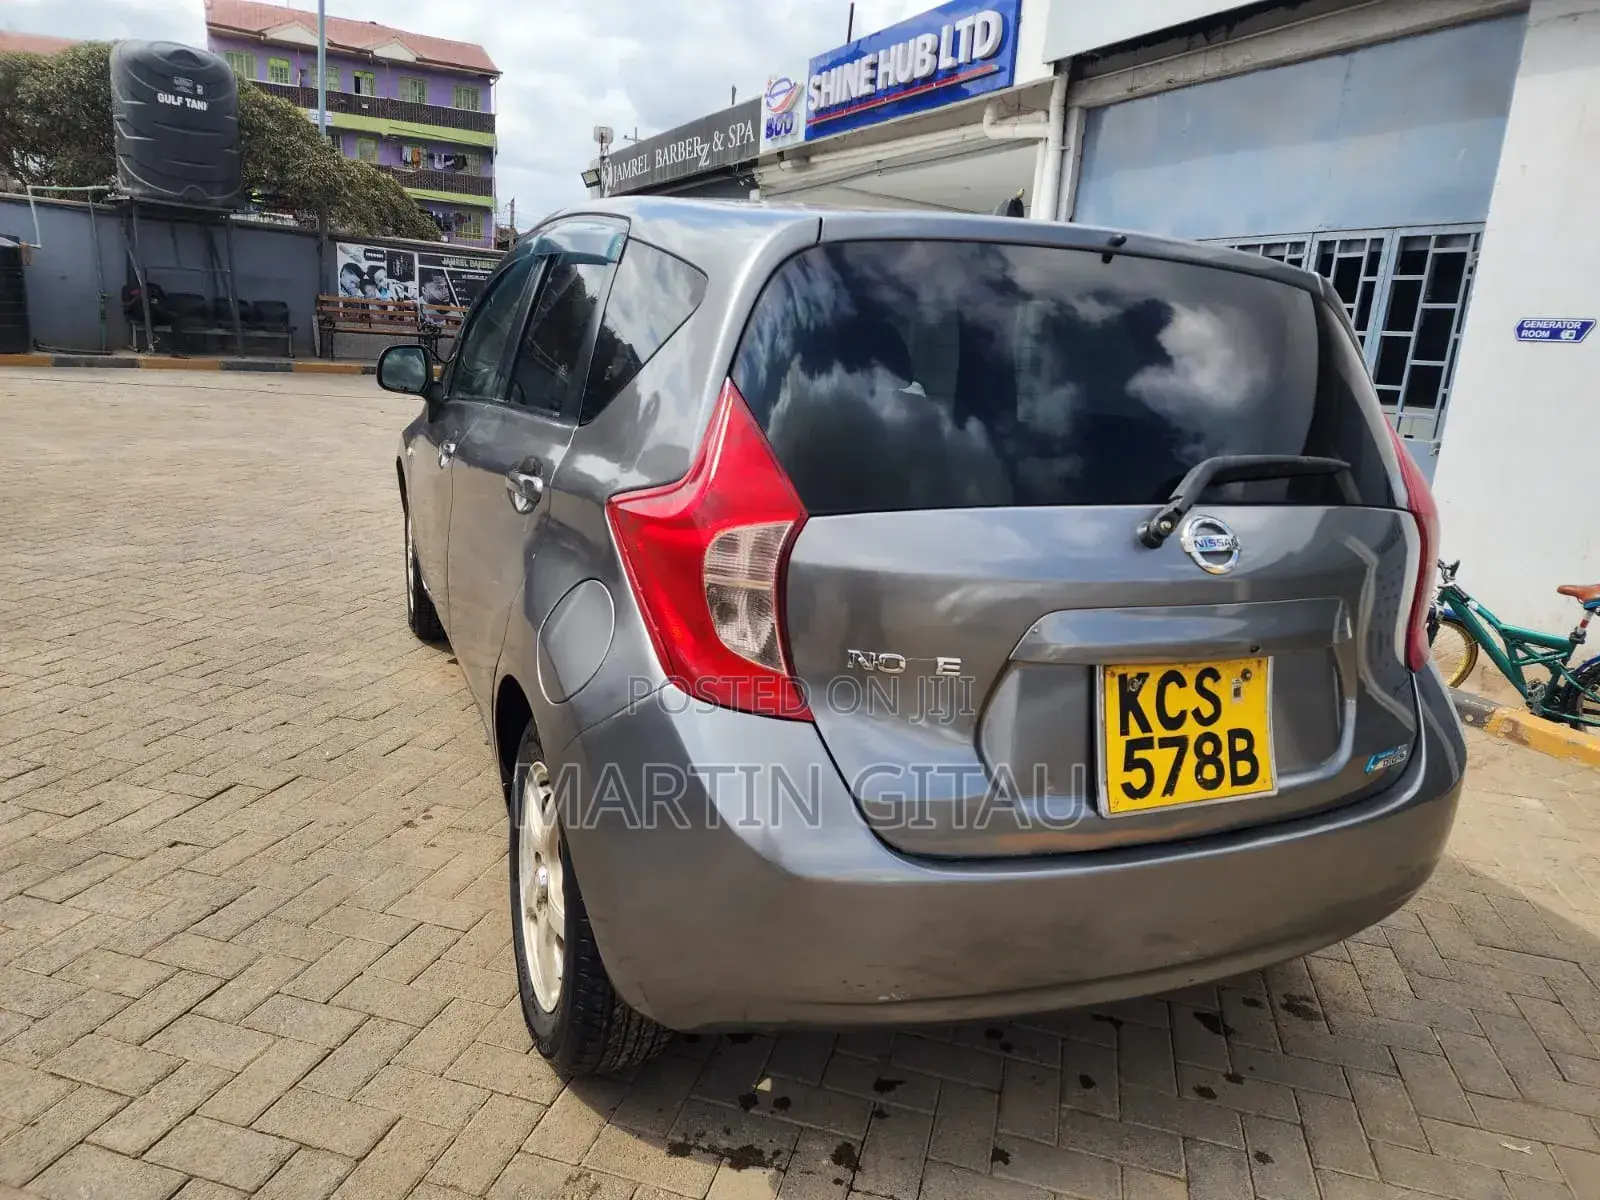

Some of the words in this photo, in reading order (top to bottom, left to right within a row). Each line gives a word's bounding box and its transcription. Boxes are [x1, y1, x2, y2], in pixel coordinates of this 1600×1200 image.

[808, 53, 878, 112] SHINE
[877, 33, 938, 90] HUB
[938, 9, 1003, 70] LTD
[157, 92, 183, 106] GULF
[612, 154, 650, 183] JAMREL
[712, 130, 725, 151] &
[728, 120, 755, 148] SPA
[1521, 329, 1550, 338] ROOM
[1523, 320, 1582, 329] GENERATOR
[1194, 537, 1239, 549] NISSAN
[1118, 667, 1223, 736] KCS
[1121, 728, 1260, 801] 578B
